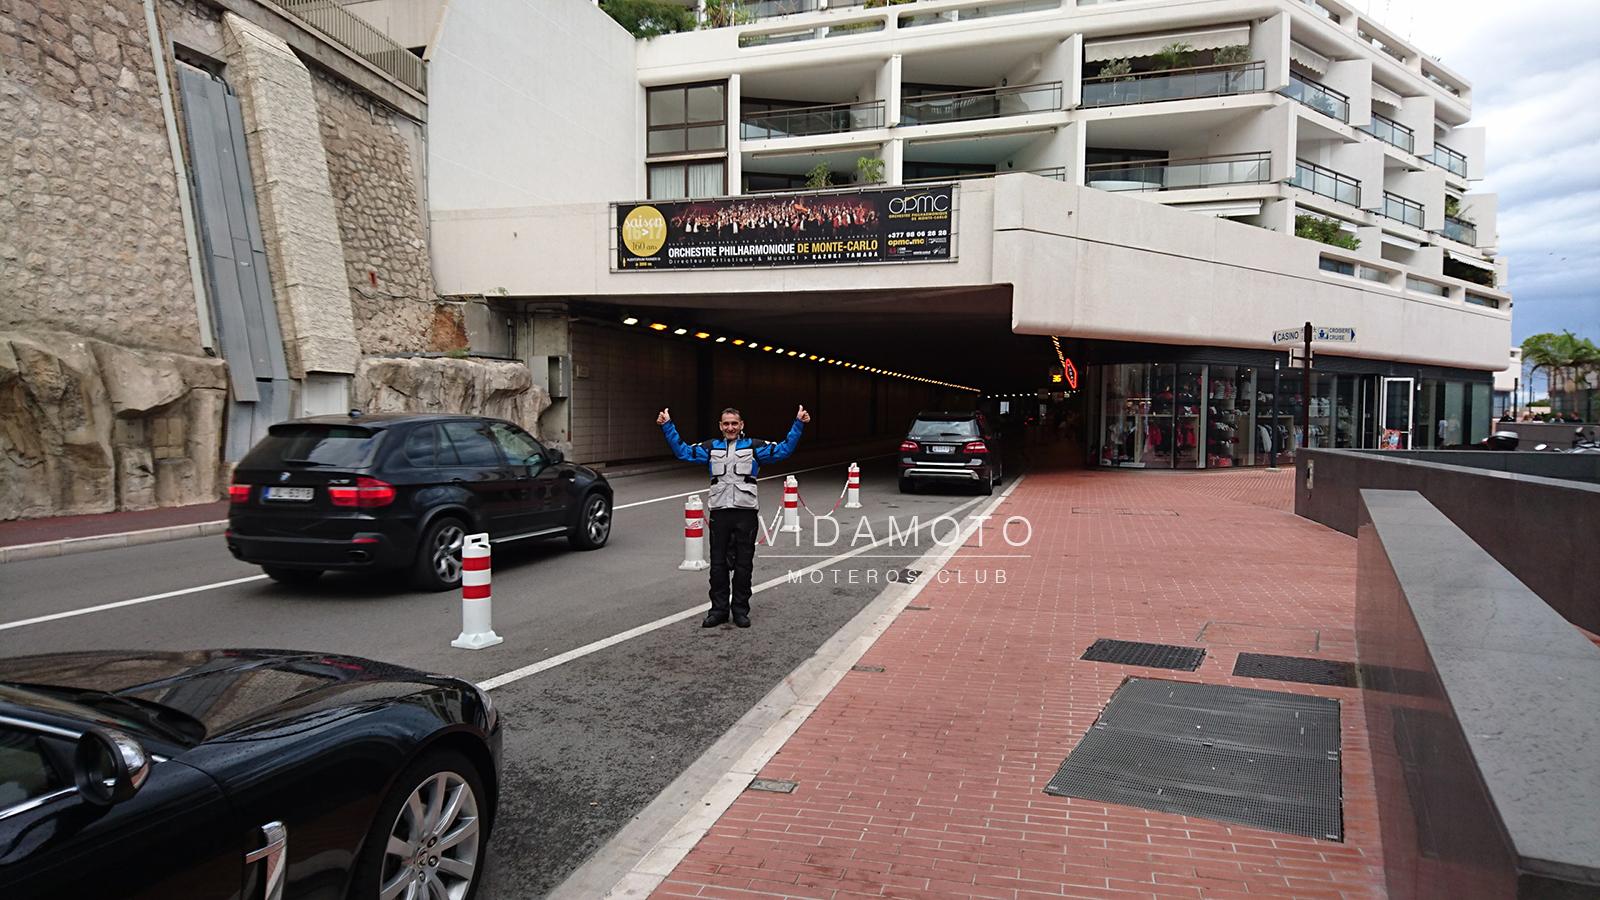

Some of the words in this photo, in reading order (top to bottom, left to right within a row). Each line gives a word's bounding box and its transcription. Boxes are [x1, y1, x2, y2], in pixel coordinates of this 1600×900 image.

[625, 215, 663, 228] saison
[632, 242, 645, 250] 160
[668, 247, 716, 258] ORCHESTRE
[719, 244, 795, 256] PHILHARMONIQUE
[797, 243, 809, 253] DE
[812, 240, 878, 252] MONTE-CARLO
[1277, 332, 1299, 341] CASINO
